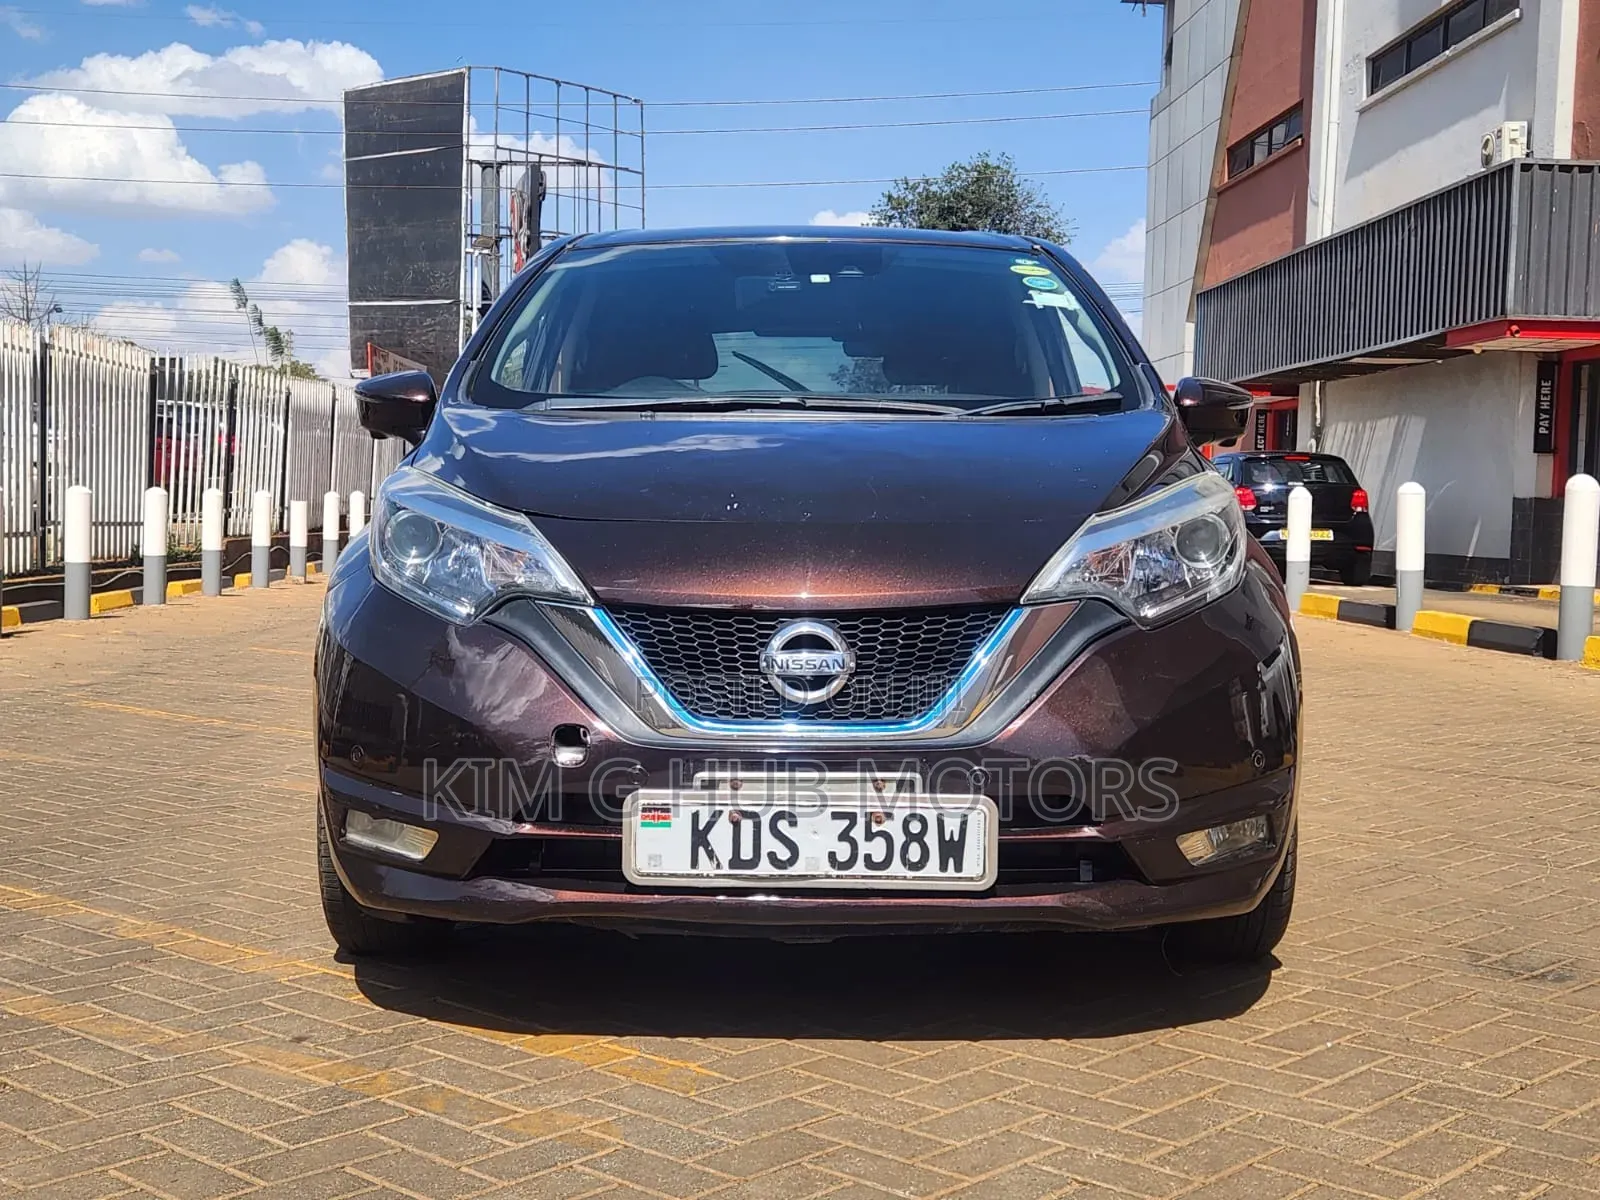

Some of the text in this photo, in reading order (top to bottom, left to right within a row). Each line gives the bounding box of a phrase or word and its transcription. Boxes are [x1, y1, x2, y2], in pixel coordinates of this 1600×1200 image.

[1539, 380, 1551, 434] PAY HERE
[768, 656, 847, 672] NISSAN
[690, 809, 801, 871] KDS
[827, 811, 968, 873] 358W
